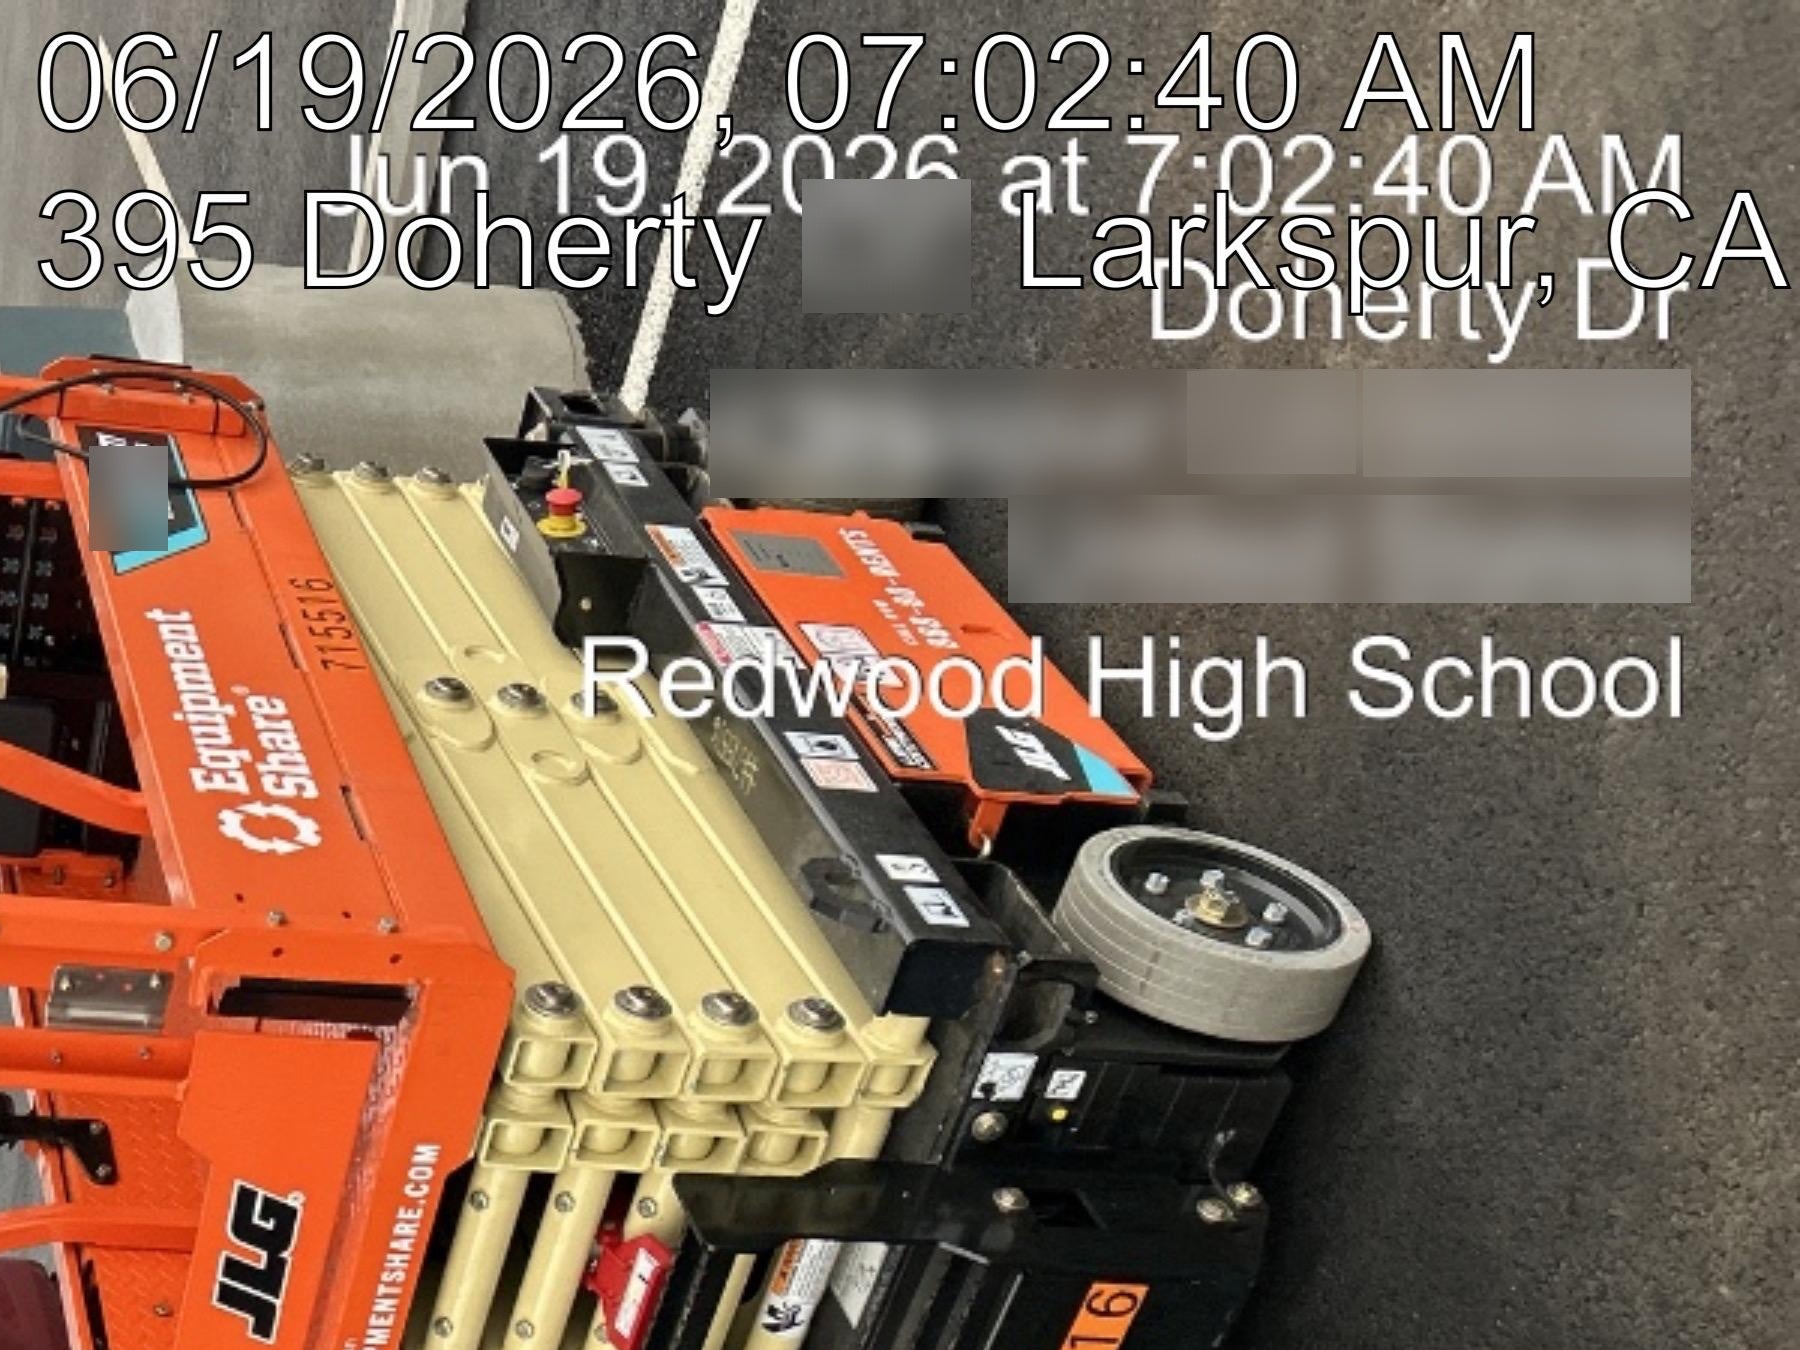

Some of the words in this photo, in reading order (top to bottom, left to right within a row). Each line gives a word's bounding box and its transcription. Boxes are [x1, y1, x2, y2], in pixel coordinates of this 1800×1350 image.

[289, 577, 367, 673] 715516
[144, 608, 252, 795] Equipment
[995, 725, 1072, 781] JLG
[210, 1179, 304, 1344] JLG
